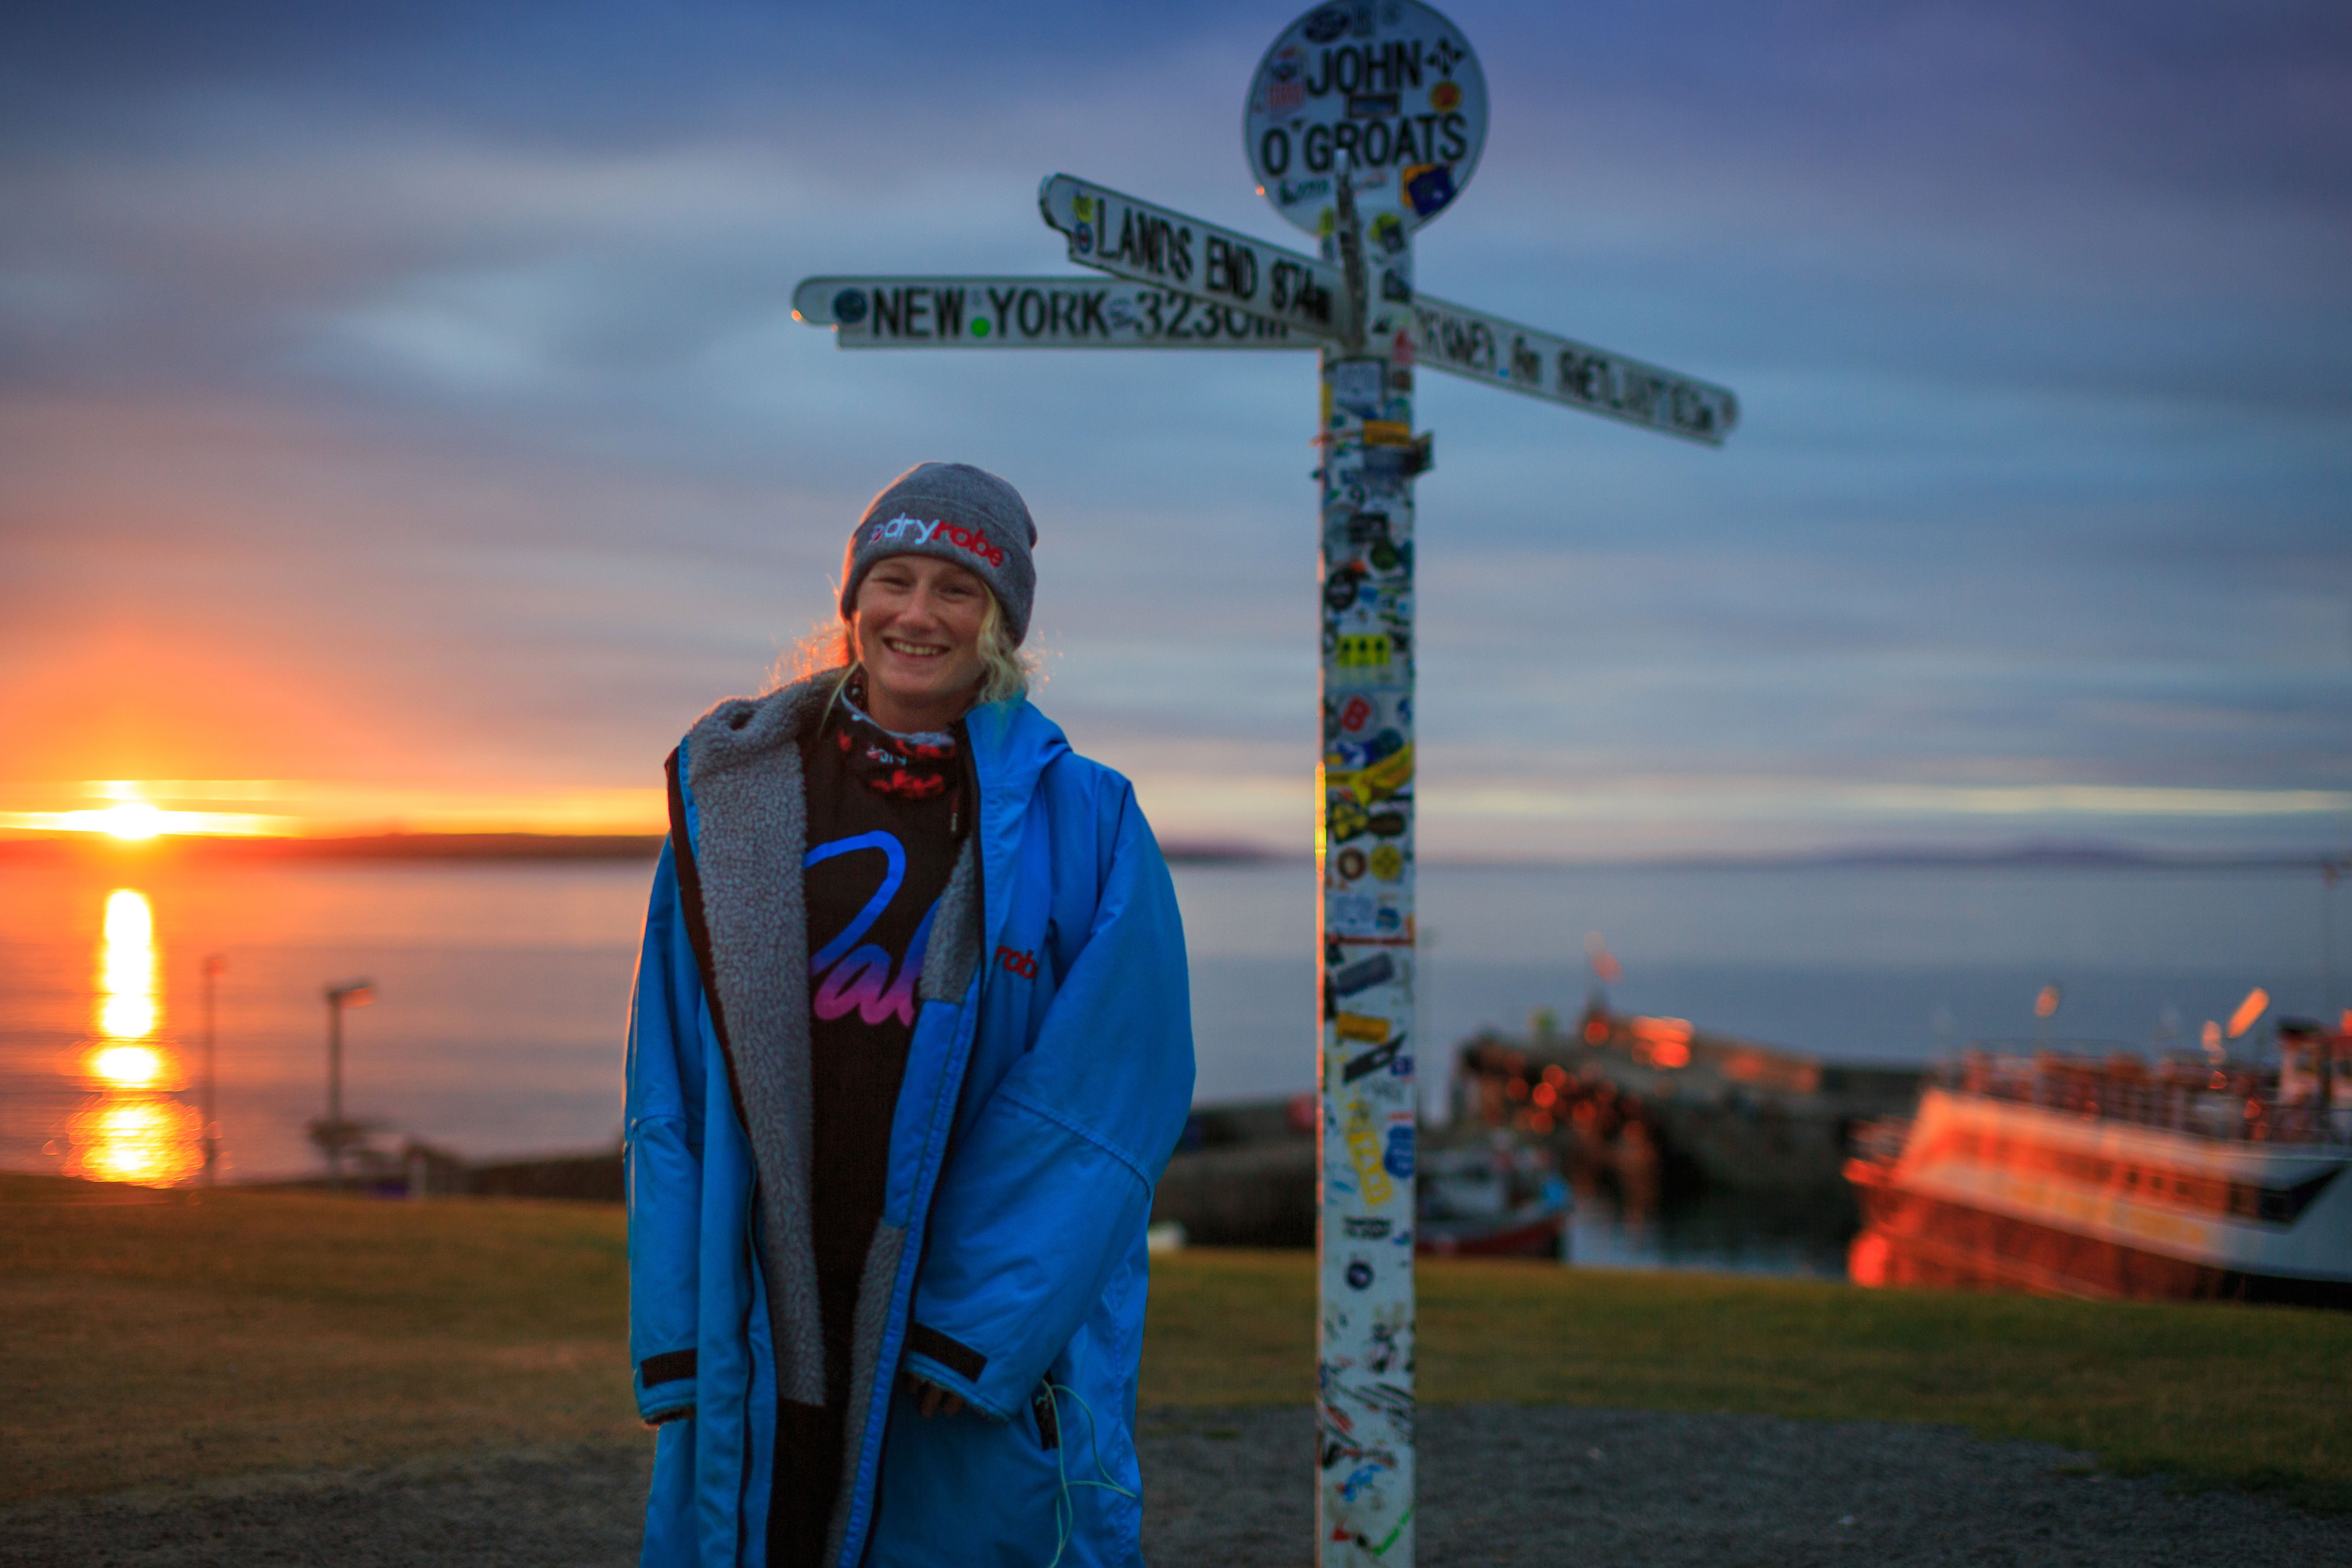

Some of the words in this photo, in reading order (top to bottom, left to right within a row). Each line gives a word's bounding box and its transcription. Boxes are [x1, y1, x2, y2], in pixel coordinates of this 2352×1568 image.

[1306, 41, 1422, 96] JOHN
[1261, 112, 1467, 176] O'GROATS
[1206, 235, 1258, 300] END
[873, 286, 965, 339] NEW
[986, 286, 1109, 339] YORK
[883, 512, 1005, 568] dryrobe
